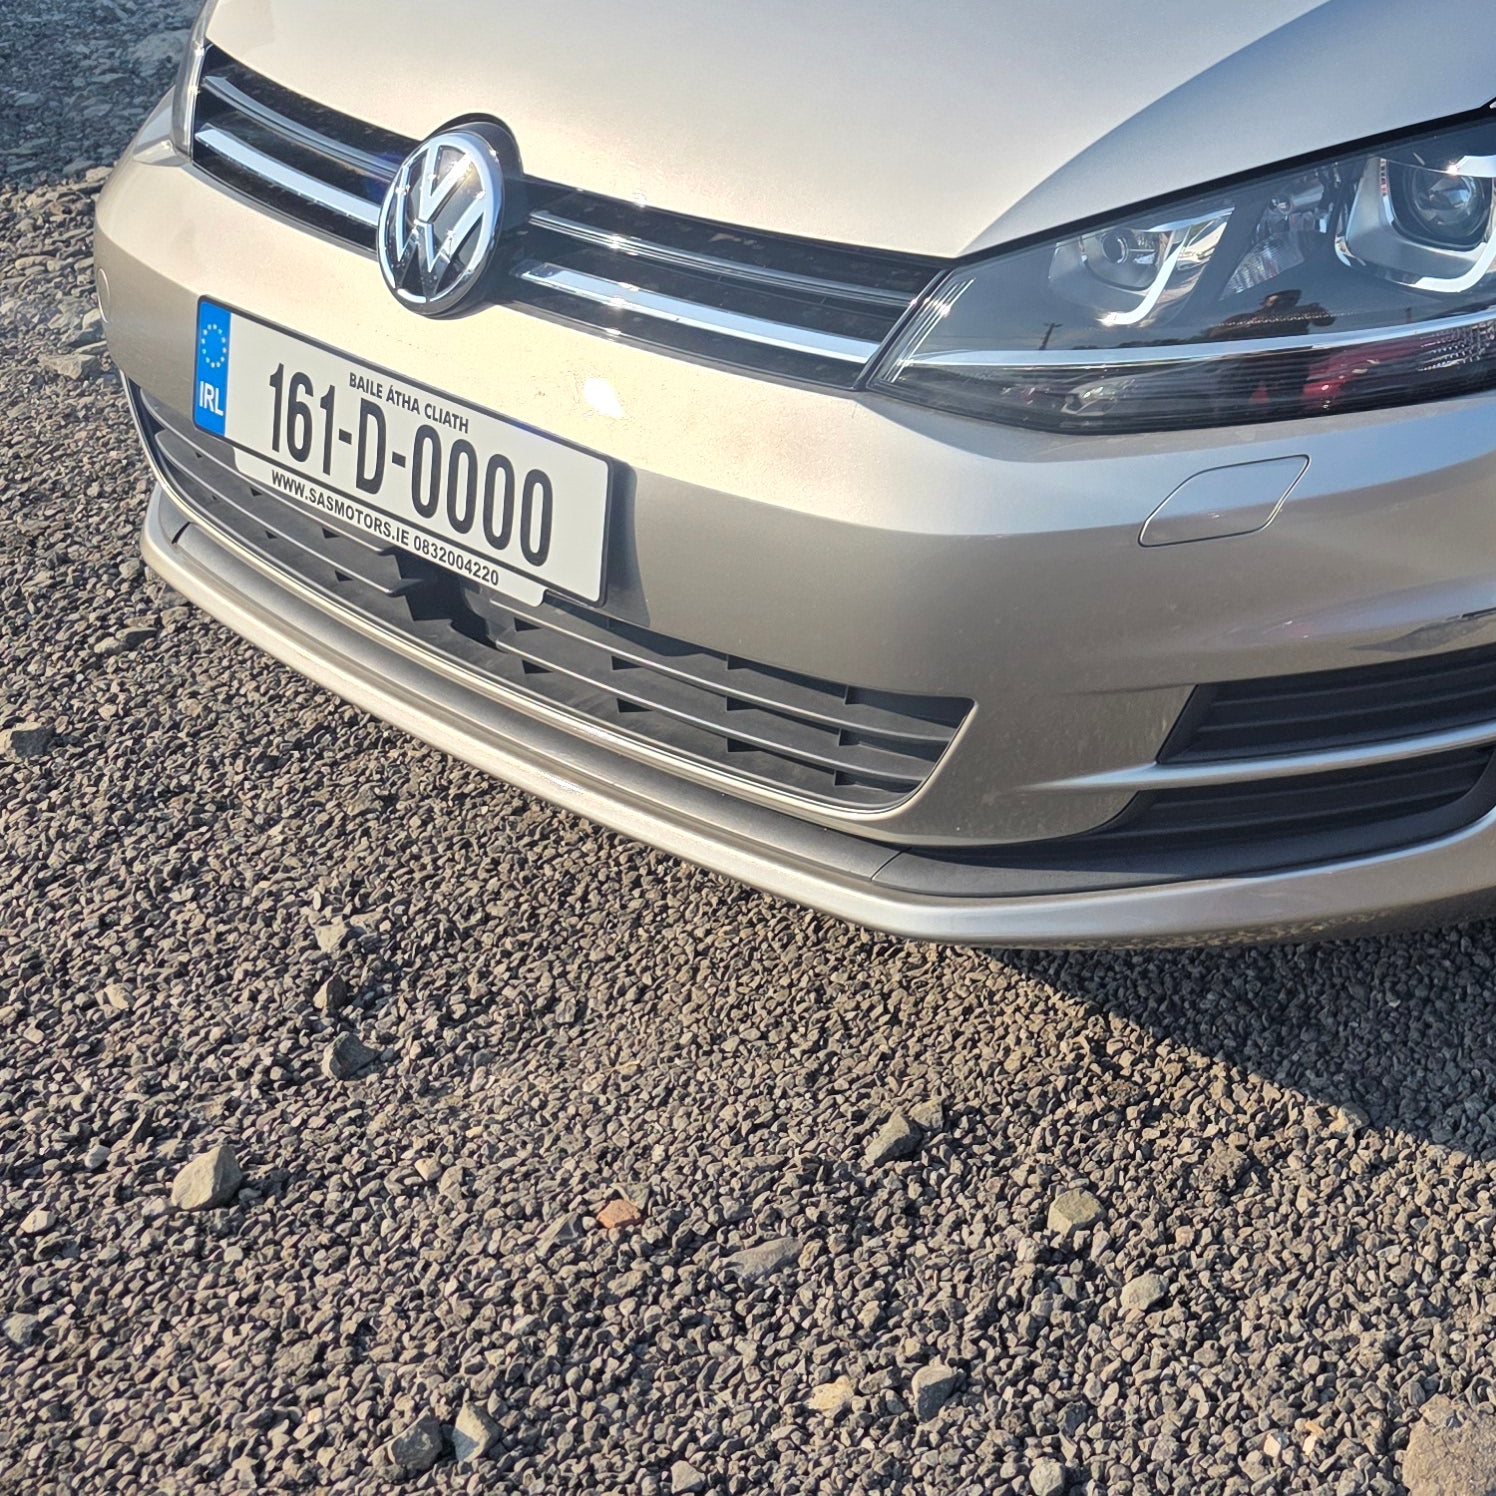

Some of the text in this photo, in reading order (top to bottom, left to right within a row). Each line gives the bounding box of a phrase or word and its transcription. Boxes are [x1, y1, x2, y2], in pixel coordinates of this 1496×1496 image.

[199, 380, 224, 416] IRL
[349, 372, 469, 434] BAILE ÁTHA CLIATH
[269, 362, 553, 567] 161-D-0000
[271, 469, 499, 586] WWW.SASMOTORS.IE 0832004220
